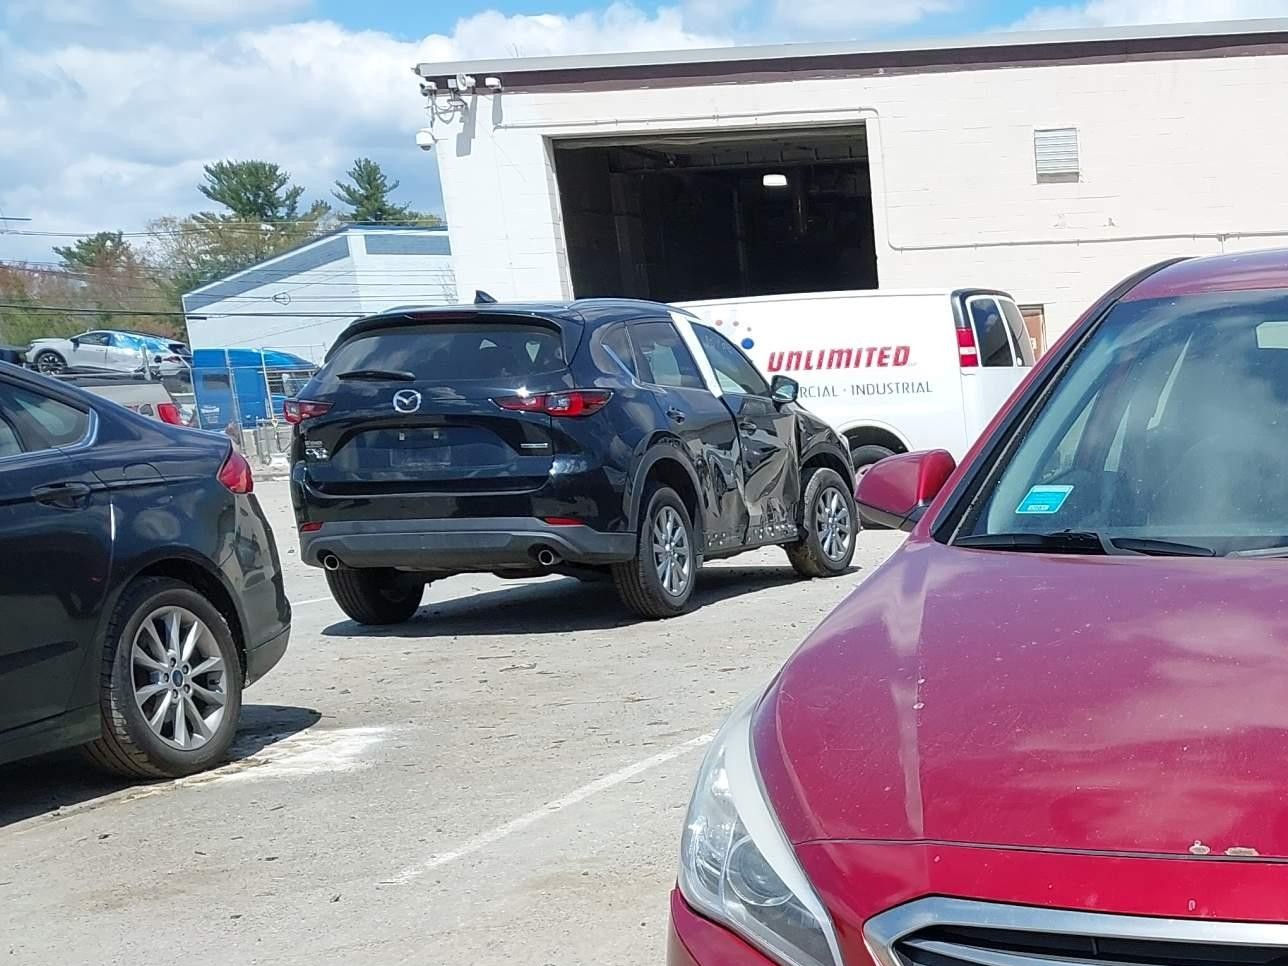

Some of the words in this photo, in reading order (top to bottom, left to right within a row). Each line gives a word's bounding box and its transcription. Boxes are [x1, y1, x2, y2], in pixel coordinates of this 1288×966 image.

[767, 345, 911, 373] UNLIMITED
[799, 384, 840, 399] RCIAL
[851, 381, 934, 397] INDUSTRIAL
